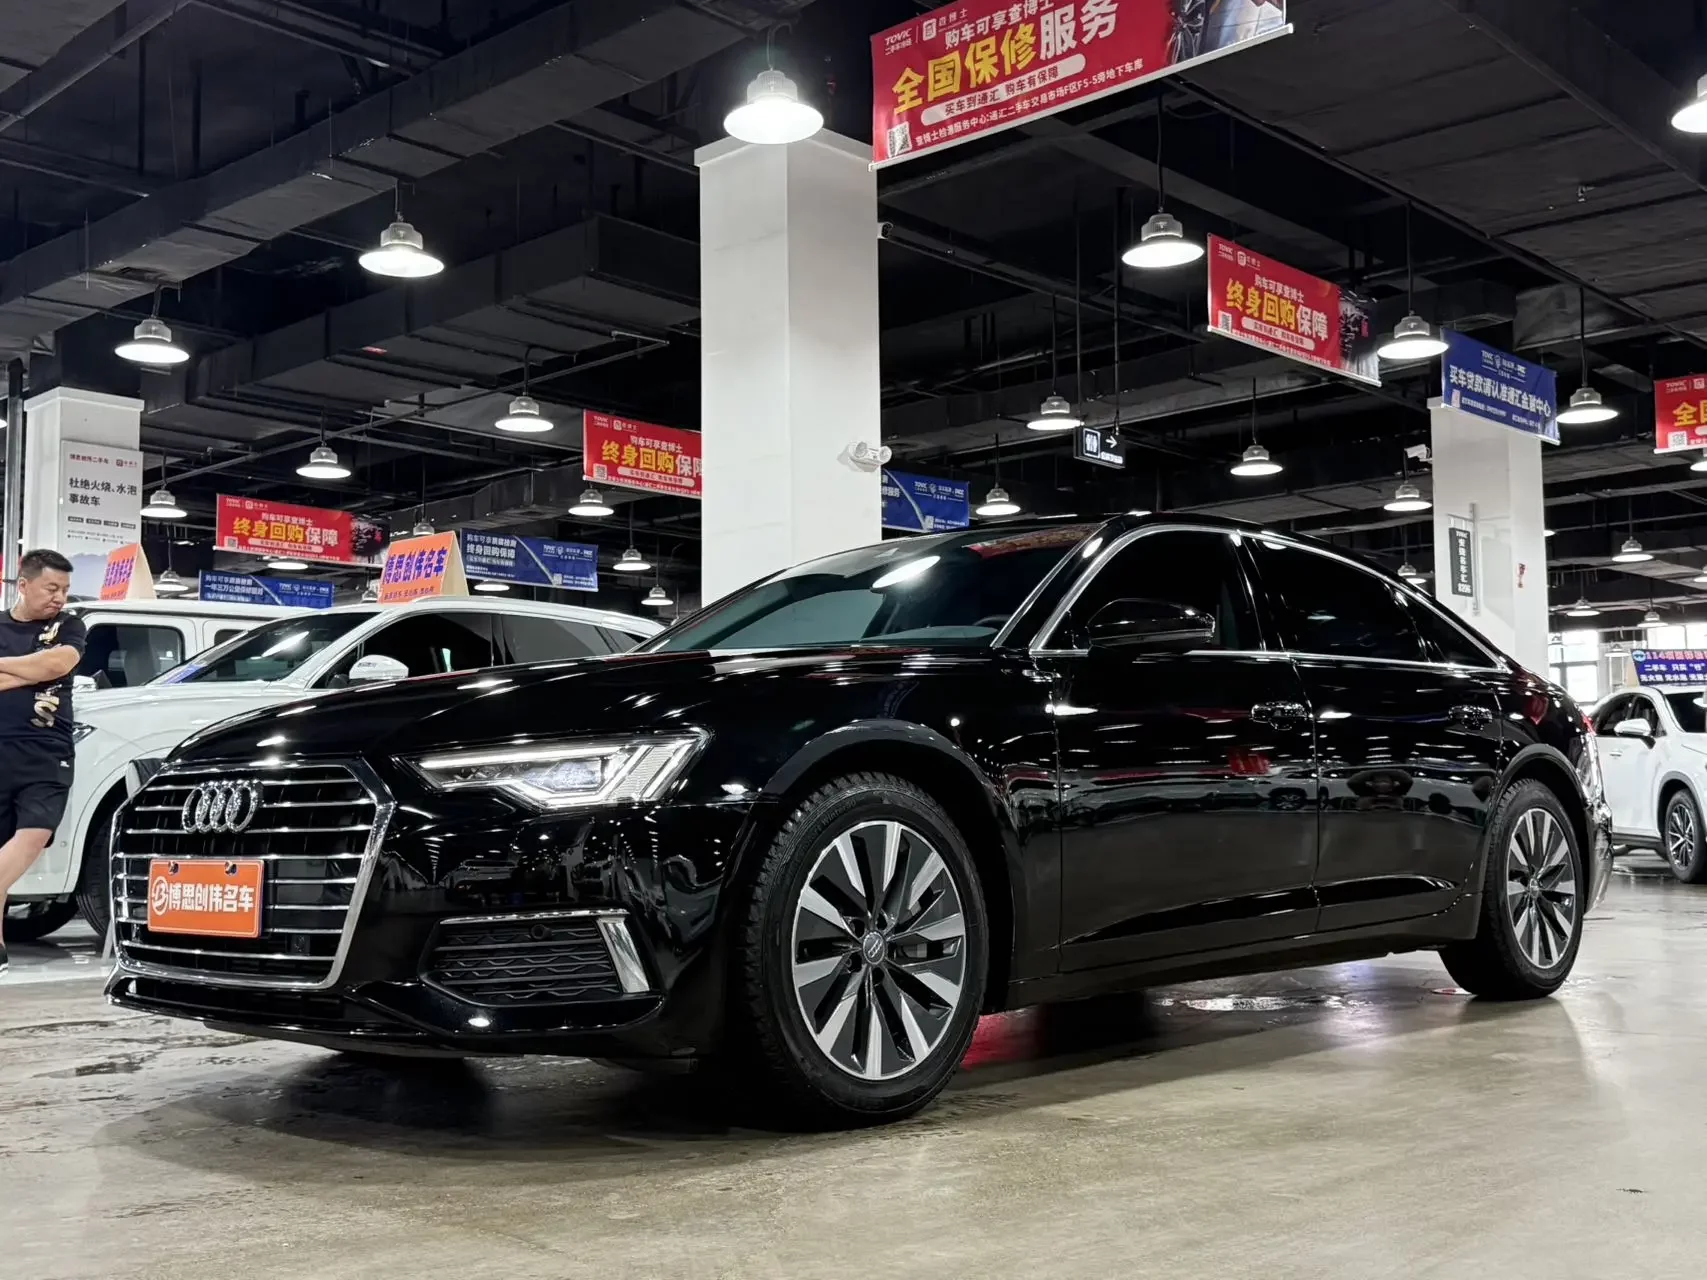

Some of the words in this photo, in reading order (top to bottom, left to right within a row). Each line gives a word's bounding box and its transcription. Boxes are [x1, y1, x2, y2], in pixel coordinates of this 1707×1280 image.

[891, 0, 1118, 113] 全国保修服务
[944, 89, 1000, 116] 买车到通汇
[1004, 66, 1060, 96] 购车有保障
[1225, 277, 1329, 342] 终身回购保障
[69, 477, 138, 496] 杜绝火烧、水泡
[69, 493, 101, 507] 事故车
[233, 517, 339, 547] 终身回购保障
[168, 882, 254, 912] 博思创伟名车
